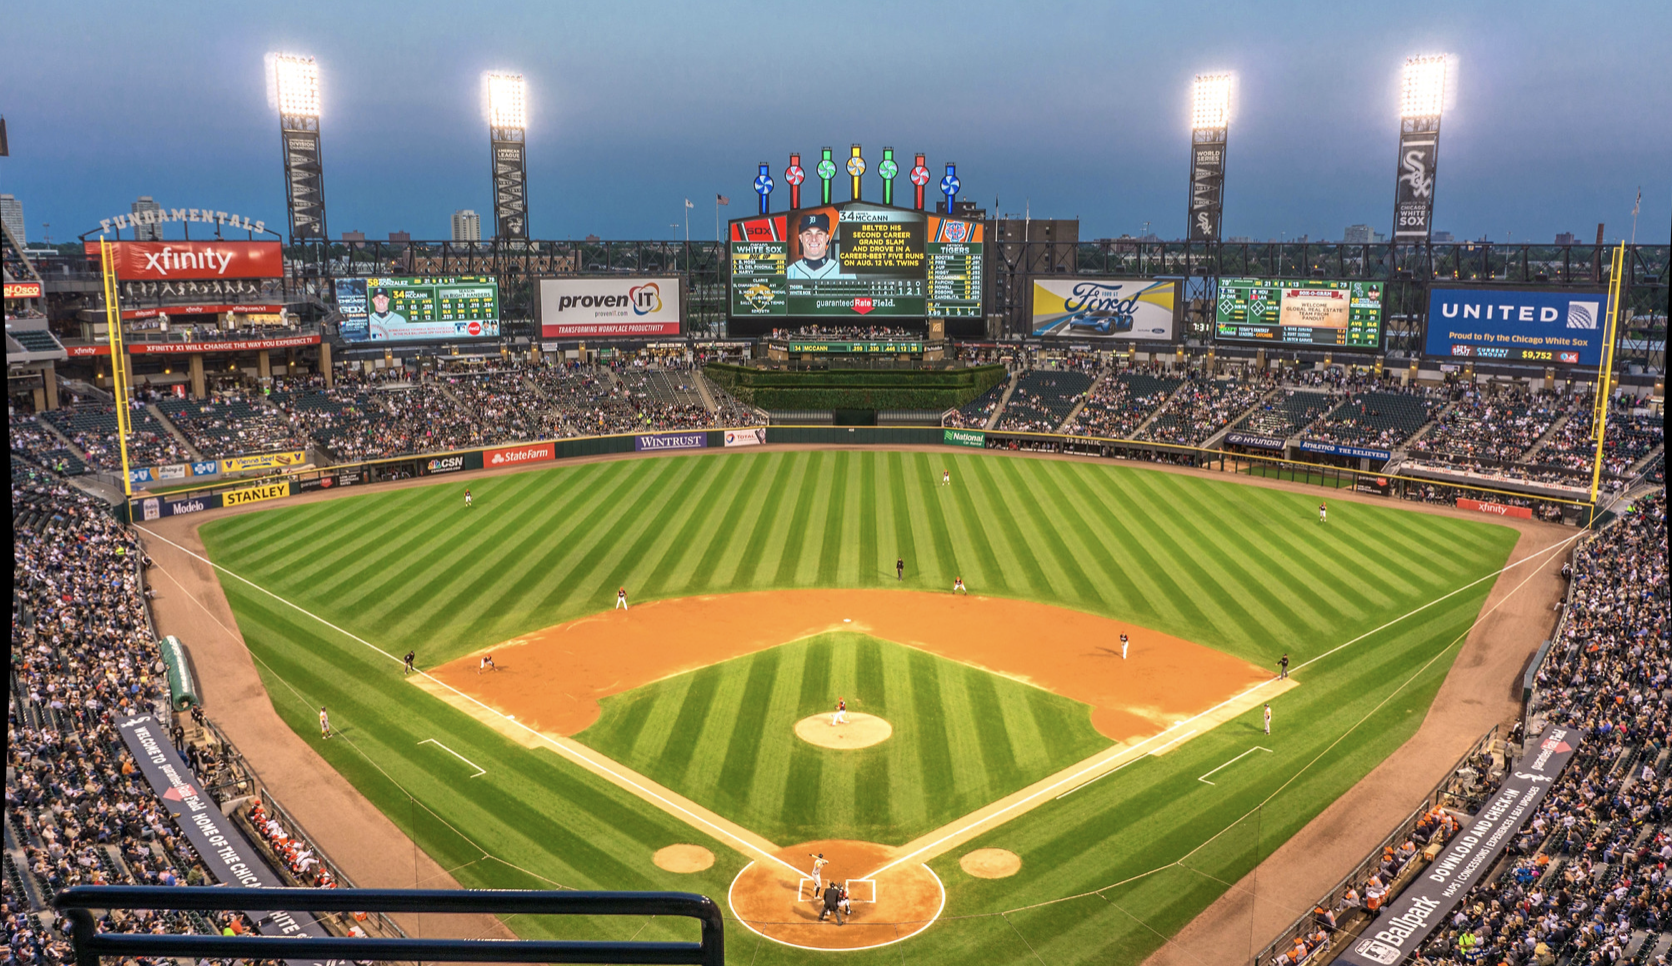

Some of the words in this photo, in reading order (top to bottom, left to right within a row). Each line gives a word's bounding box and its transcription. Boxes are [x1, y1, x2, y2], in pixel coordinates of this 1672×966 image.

[100, 208, 265, 234] FUNDAMENTALS
[839, 211, 855, 221] 34
[1399, 216, 1425, 226] SOX
[746, 227, 771, 235] SOX
[852, 231, 882, 239] SECOND
[883, 231, 911, 239] CAREER
[839, 252, 887, 260] CAREER-BEST
[887, 252, 904, 260] FIVE
[905, 252, 925, 260] RUNS
[940, 246, 970, 254] TIGERS
[145, 247, 232, 275] xfinity
[367, 278, 379, 287] 58
[393, 290, 405, 299] 34
[906, 287, 912, 295] 2
[1064, 282, 1143, 314] Ford
[558, 294, 629, 312] proven
[638, 292, 654, 307] IT
[816, 299, 854, 308] guaranteed
[855, 298, 871, 307] Rate
[594, 310, 629, 318] provenIT.com
[1442, 303, 1559, 322] UNITED
[558, 325, 598, 334] TRANSFORMING
[598, 324, 628, 333] WORKPLACE
[628, 324, 664, 332] PRODUCTIVITY
[276, 338, 306, 346] EXPERIENCE
[1449, 331, 1473, 341] Proud
[1473, 333, 1483, 341] to
[1484, 332, 1495, 342] fly
[1496, 333, 1510, 342] the
[1511, 335, 1543, 345] Chicago
[1545, 336, 1571, 346] White
[1572, 338, 1588, 346] Sox
[1522, 350, 1552, 360] $9,752
[640, 436, 702, 448] WINTRUST
[953, 433, 984, 442] National
[1243, 437, 1282, 448] HYUNDAI
[505, 451, 527, 462] State
[527, 449, 548, 459] Farm
[1302, 442, 1335, 451] ATHLETICO
[1352, 449, 1389, 459] RELIEVERS
[236, 458, 260, 466] Vienna
[441, 457, 463, 468] CSN
[228, 485, 285, 504] STANLEY
[173, 501, 204, 515] Modelo
[1478, 502, 1508, 515] xfinity
[134, 726, 162, 756] WELCOME
[150, 754, 167, 764] TO
[157, 763, 187, 787] guaranteed
[183, 792, 208, 812] Field
[1517, 785, 1540, 809] UPGRADES
[1511, 803, 1526, 821] SEAT
[192, 812, 220, 838] HOME
[208, 832, 228, 851] OF
[1429, 829, 1478, 883] DOWNLOAD
[1470, 814, 1493, 840] AND
[1483, 787, 1521, 822] CHECK-IN
[1485, 818, 1515, 852] EXPERIENCES
[217, 845, 238, 865] THE
[1459, 847, 1490, 882] CONCESSIONS
[1441, 877, 1462, 898] MAPS
[267, 910, 301, 937] HITE
[1374, 894, 1441, 948] Ballpark
